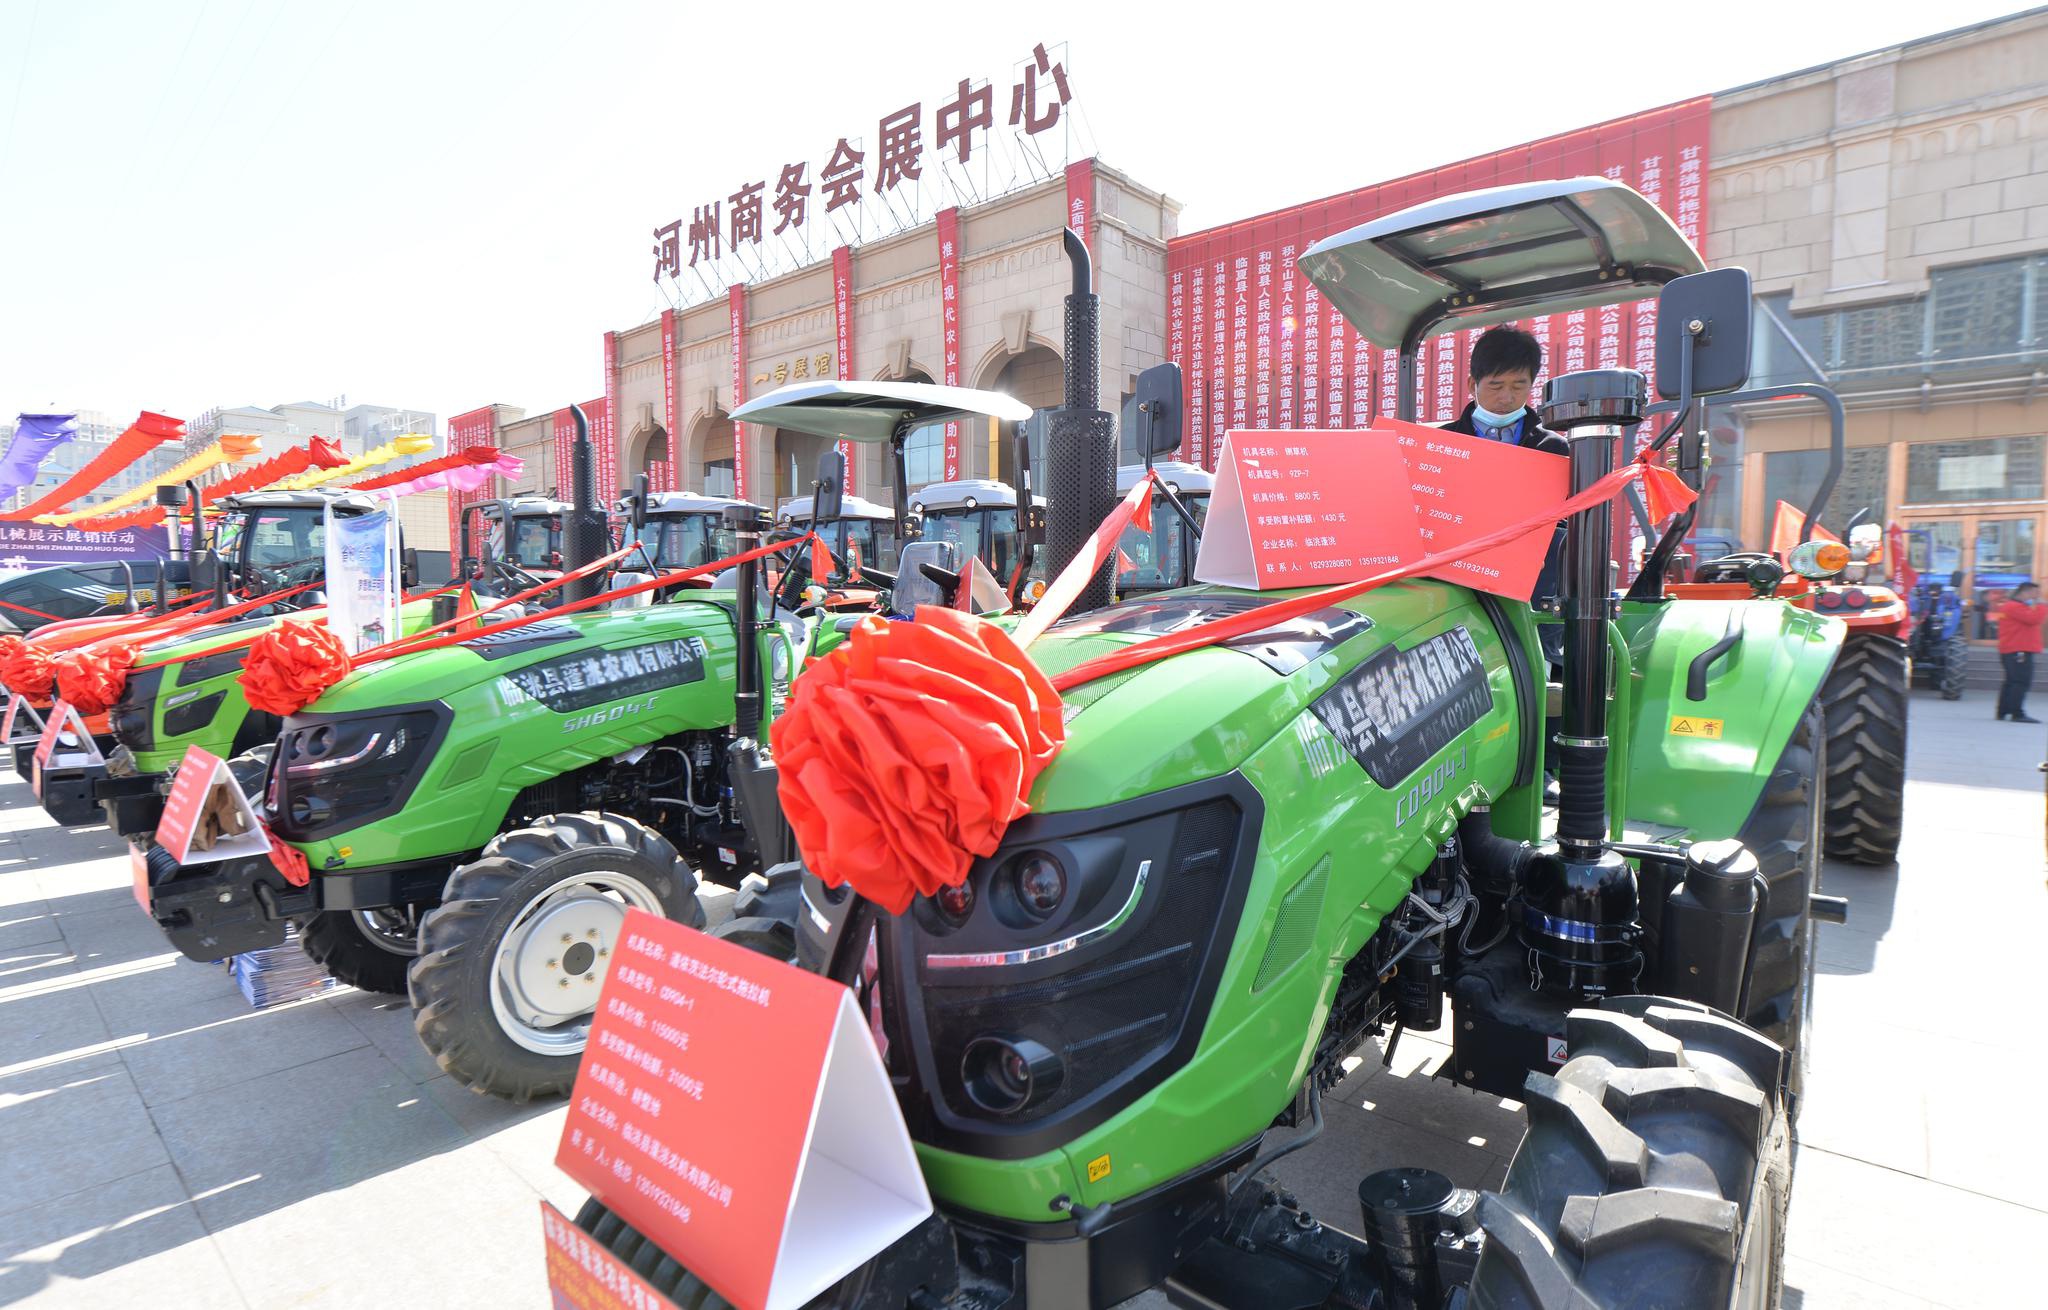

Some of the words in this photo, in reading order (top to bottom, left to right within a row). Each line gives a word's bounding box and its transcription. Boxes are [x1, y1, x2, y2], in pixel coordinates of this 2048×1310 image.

[652, 42, 1072, 284] 河州商务会展中心
[753, 351, 832, 385] 一号展馆
[1418, 462, 1442, 474] SD704
[1426, 442, 1471, 460] 轮式拖拉机
[562, 696, 661, 734] SH604-C
